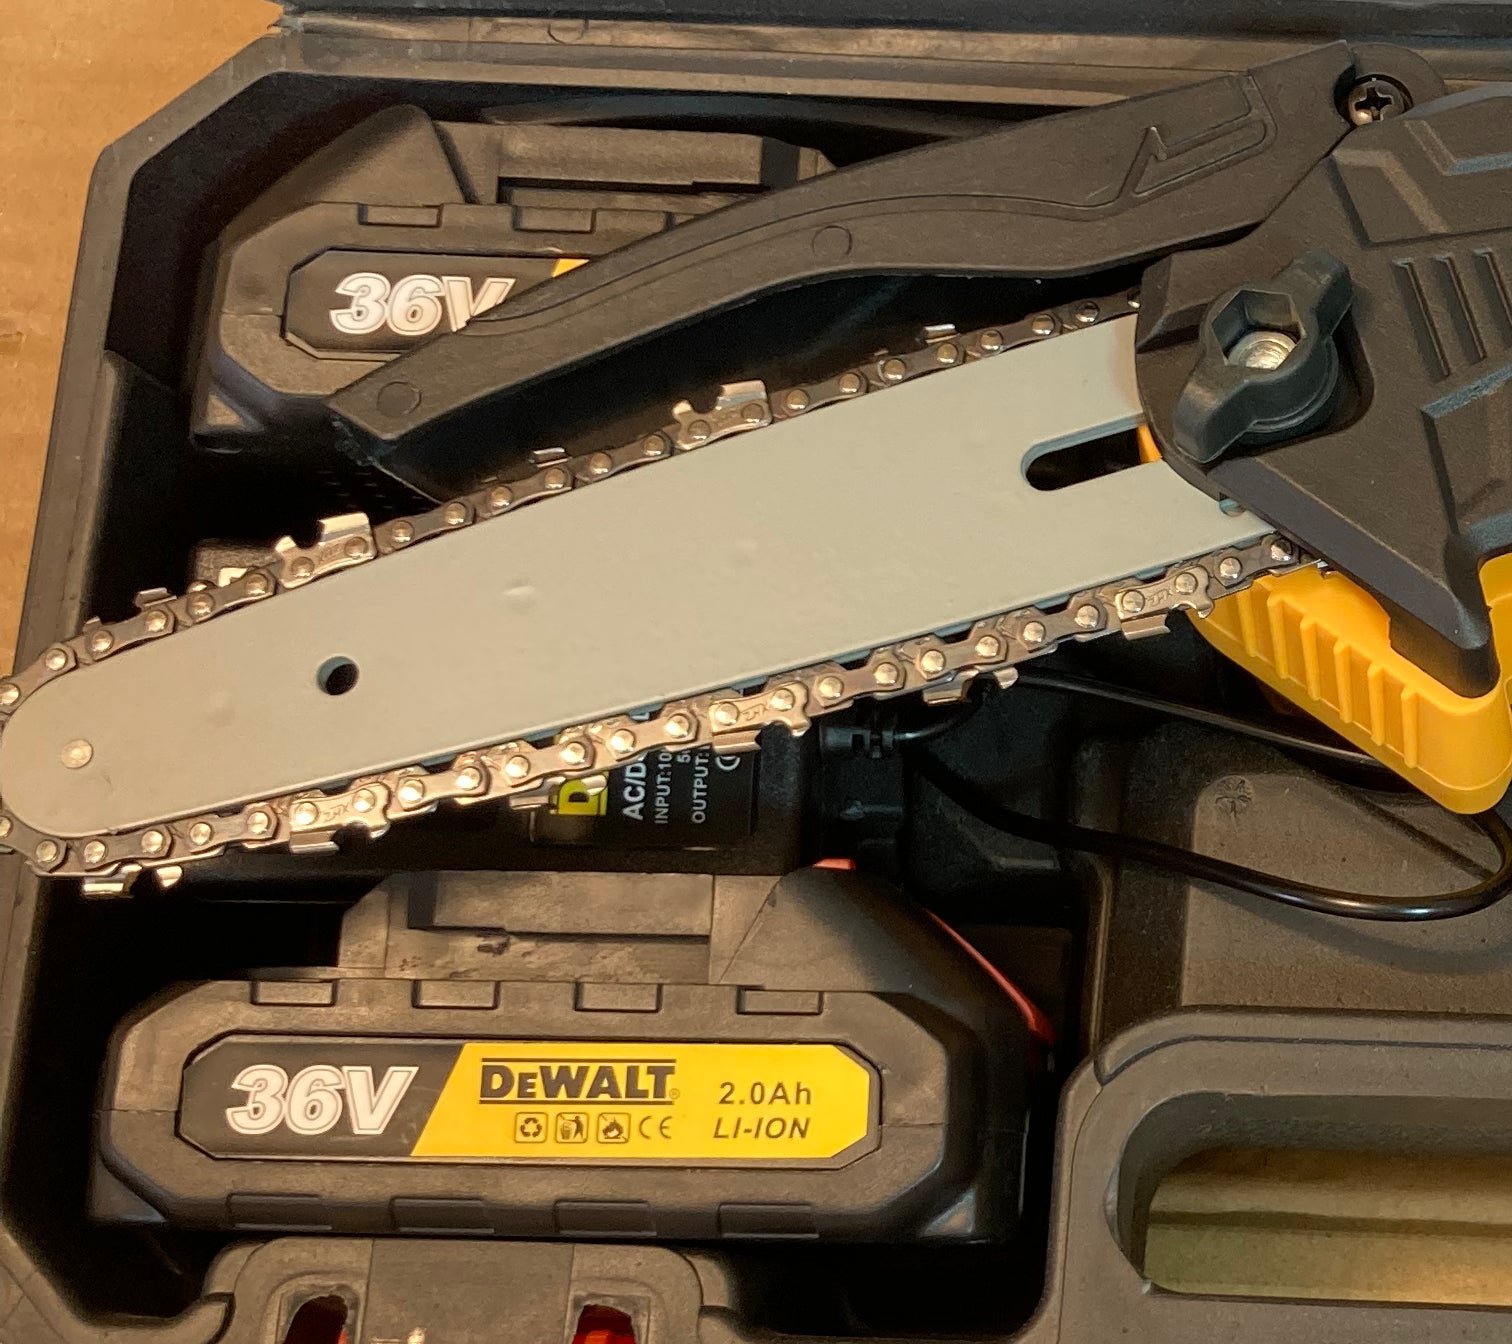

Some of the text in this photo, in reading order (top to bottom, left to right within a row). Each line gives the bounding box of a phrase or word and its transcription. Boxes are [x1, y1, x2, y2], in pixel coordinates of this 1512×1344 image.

[329, 272, 516, 336] 36V
[225, 1064, 419, 1135] 36V
[719, 1081, 813, 1105] 2.0Ah
[712, 1117, 810, 1140] LI-ION
